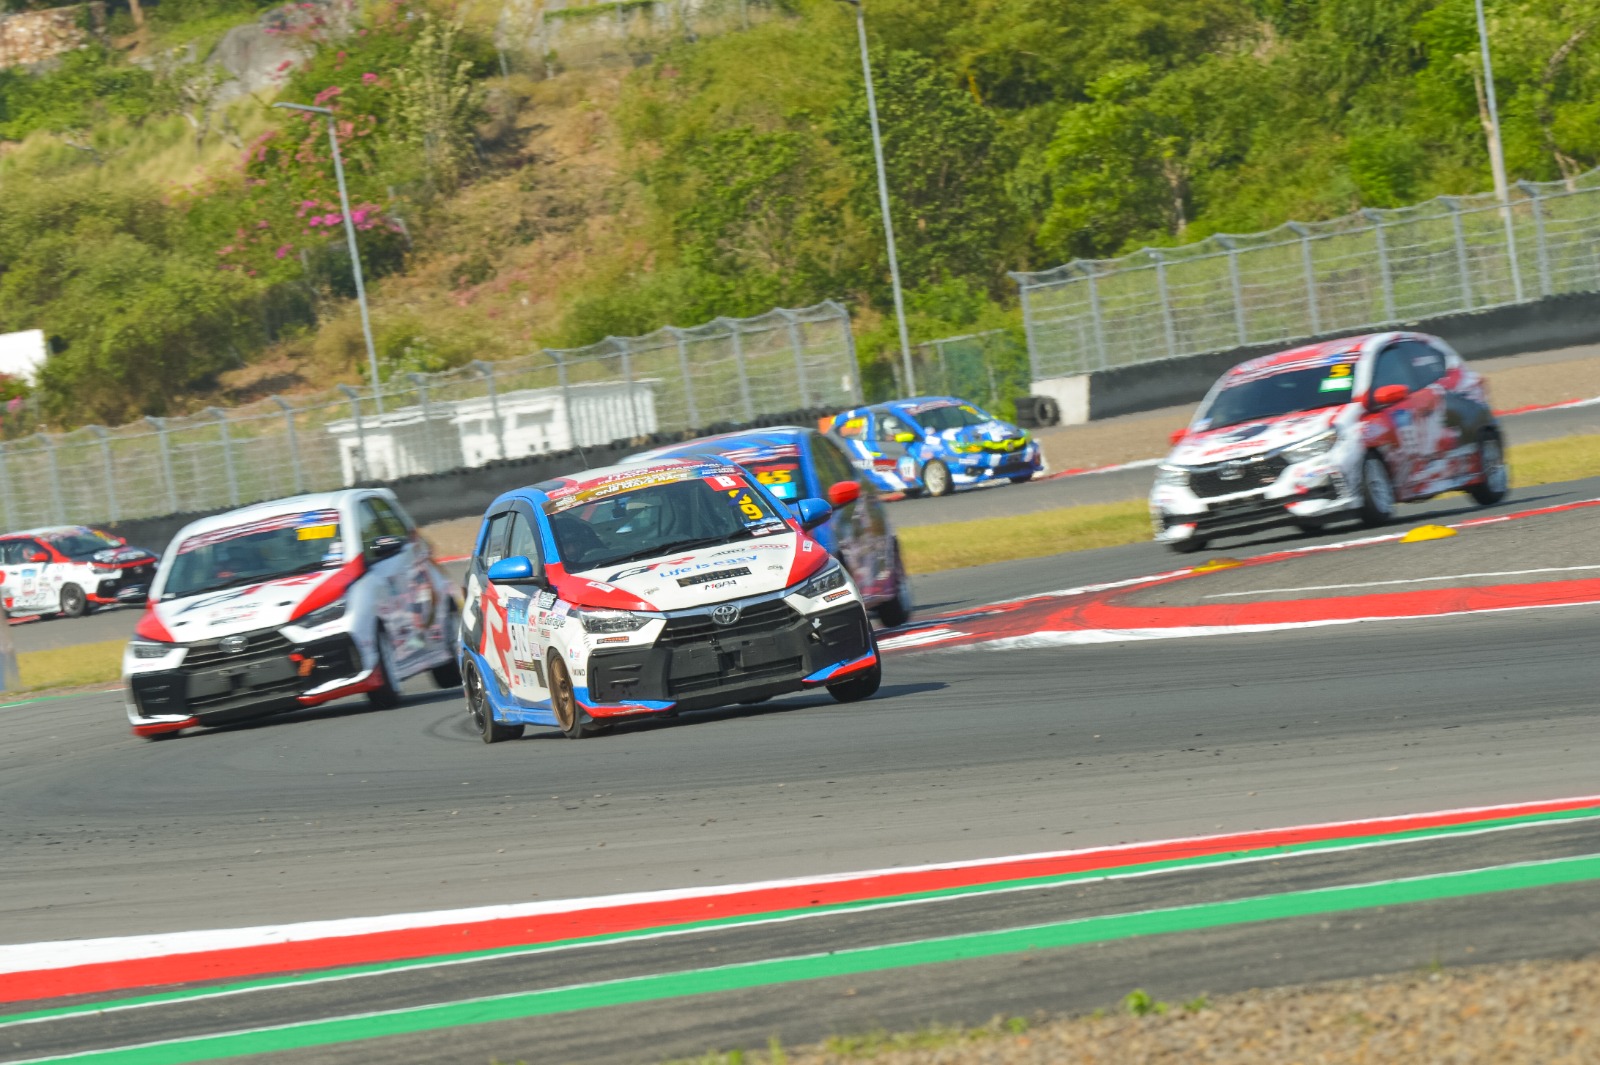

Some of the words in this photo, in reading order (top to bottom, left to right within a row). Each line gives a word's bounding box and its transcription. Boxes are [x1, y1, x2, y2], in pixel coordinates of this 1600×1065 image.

[660, 472, 688, 483] RACE
[716, 475, 737, 488] B
[659, 567, 692, 578] Life
[696, 561, 711, 570] is
[713, 555, 758, 567] easy
